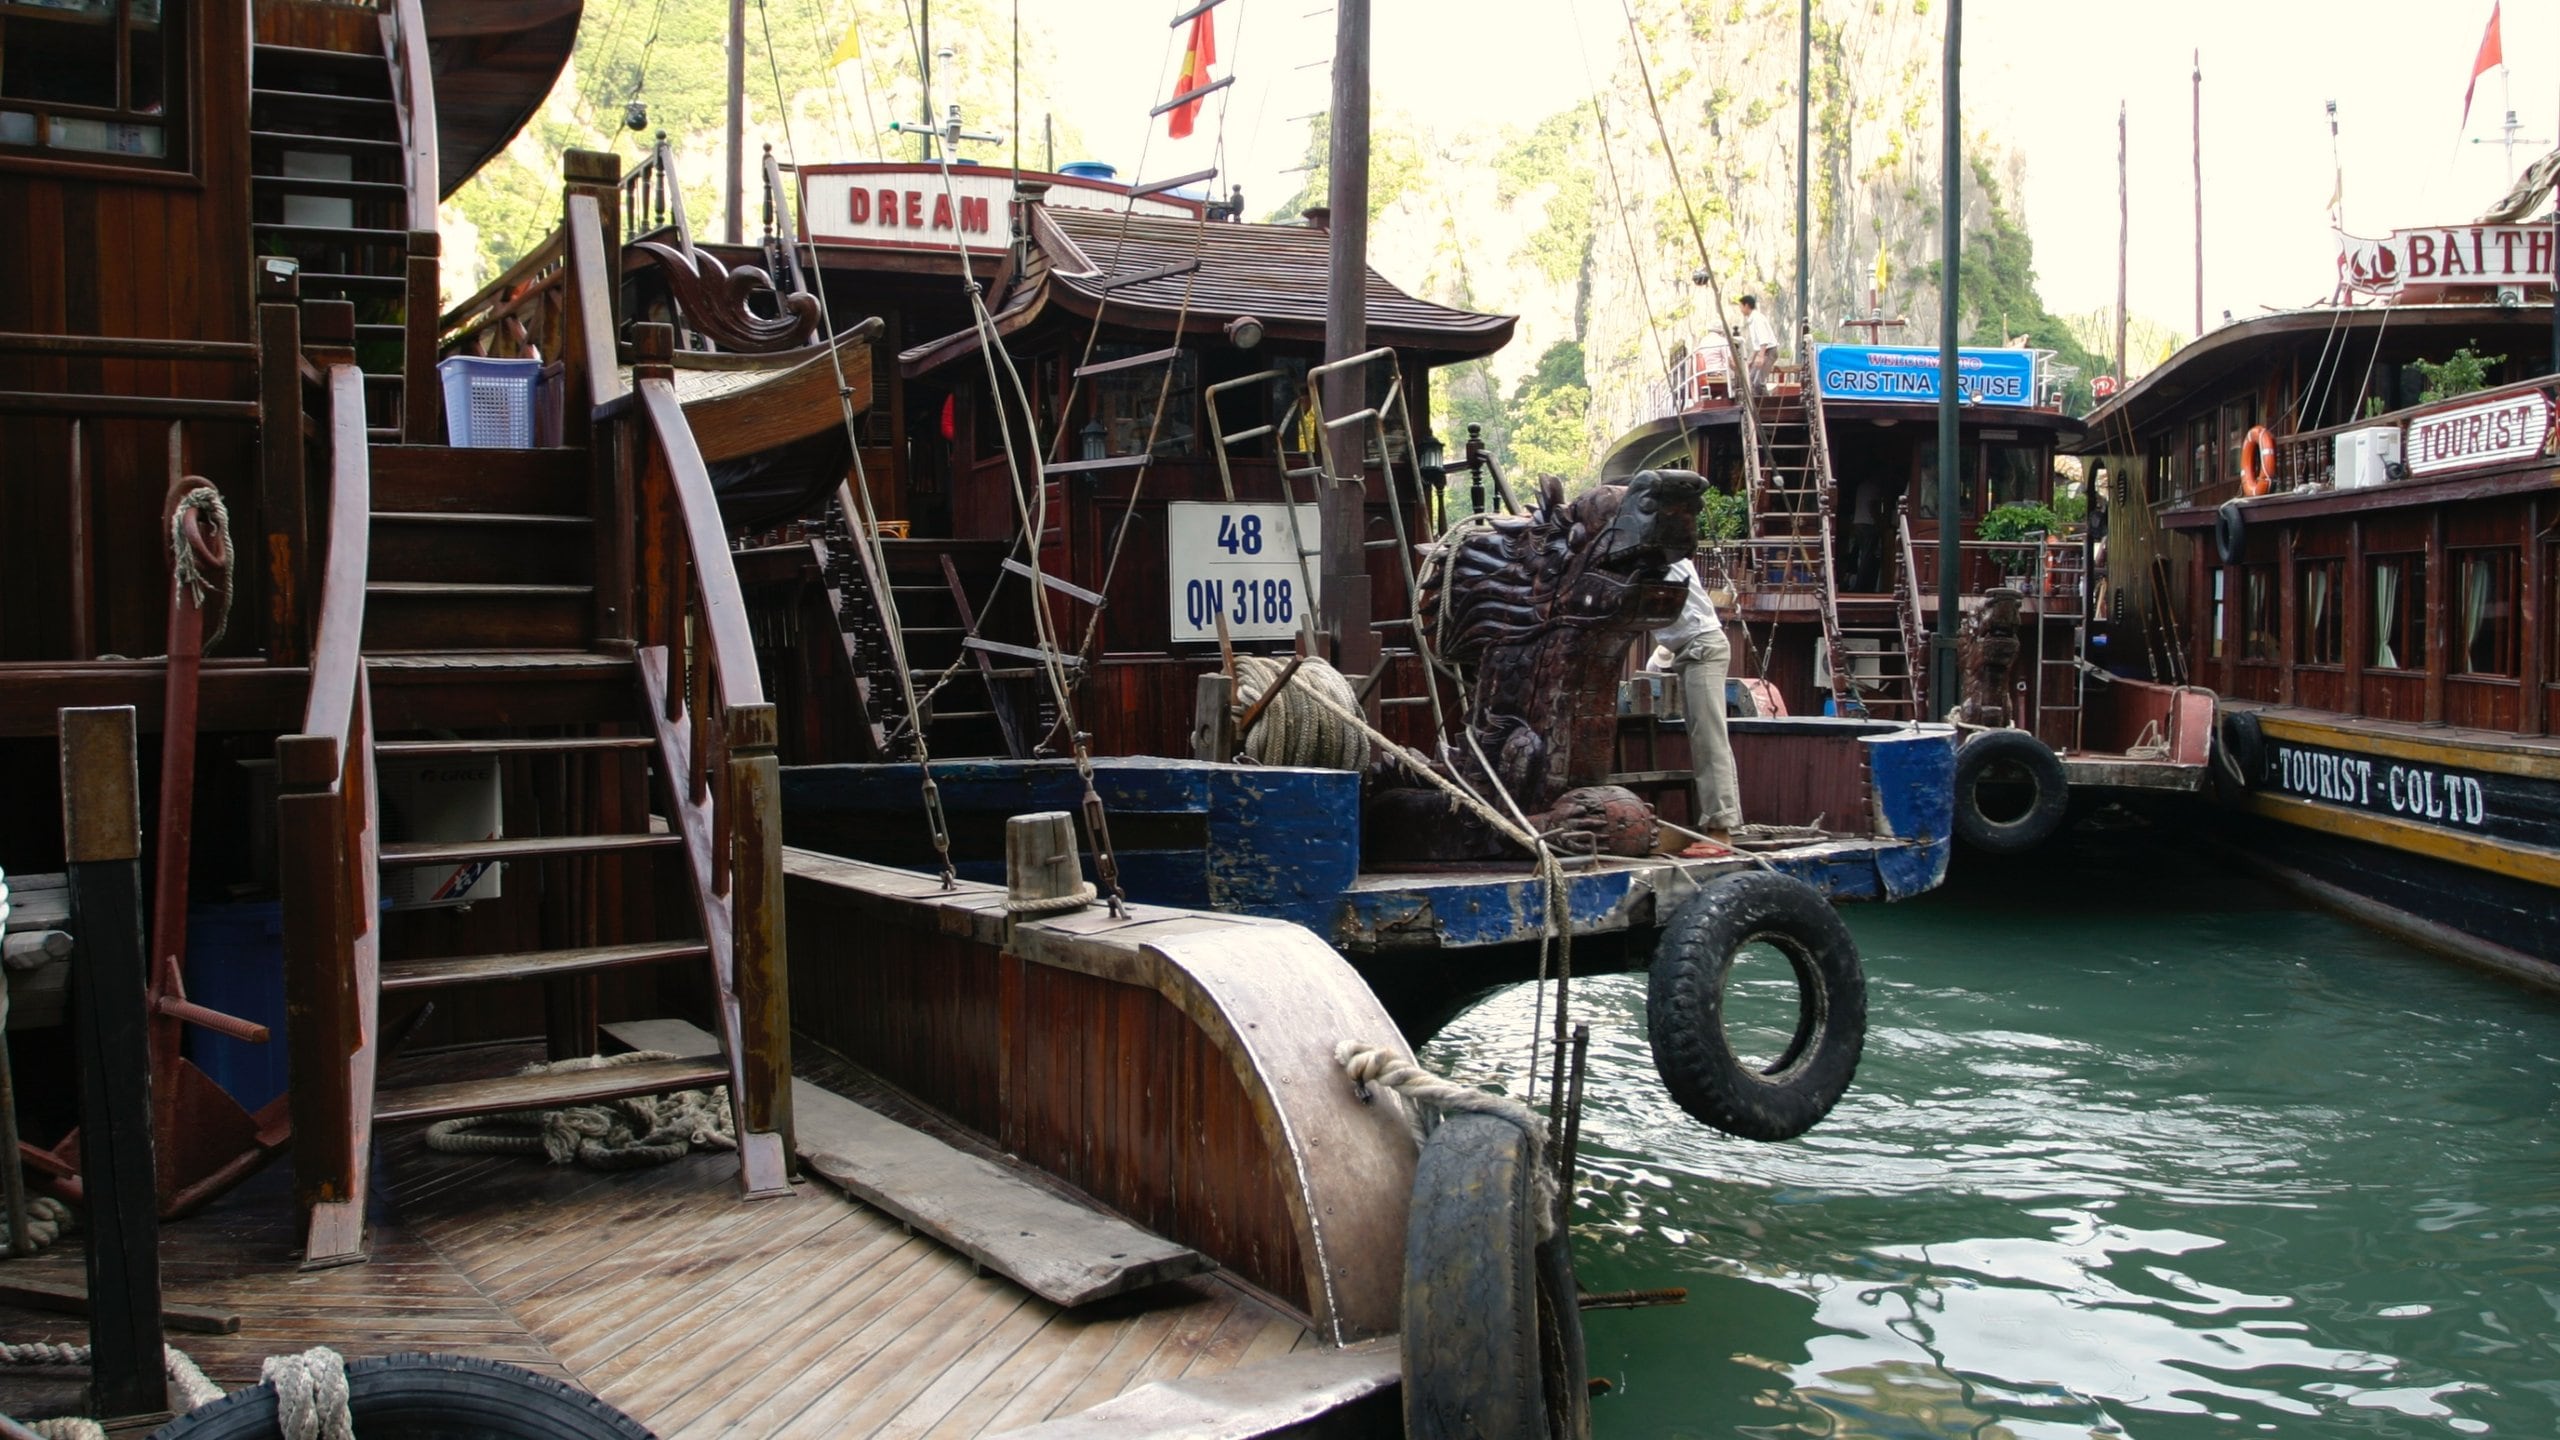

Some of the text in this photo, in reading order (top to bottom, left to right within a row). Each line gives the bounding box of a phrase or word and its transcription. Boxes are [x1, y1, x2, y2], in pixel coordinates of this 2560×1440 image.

[850, 187, 988, 233] DREAM
[1827, 371, 2021, 396] CRISTINA RUISE
[1868, 353, 1941, 369] WELCOM
[2420, 406, 2532, 463] TOURIST
[1217, 514, 1263, 555] 48
[1186, 578, 1294, 632] QN 3188
[2279, 747, 2372, 806] TOURIST
